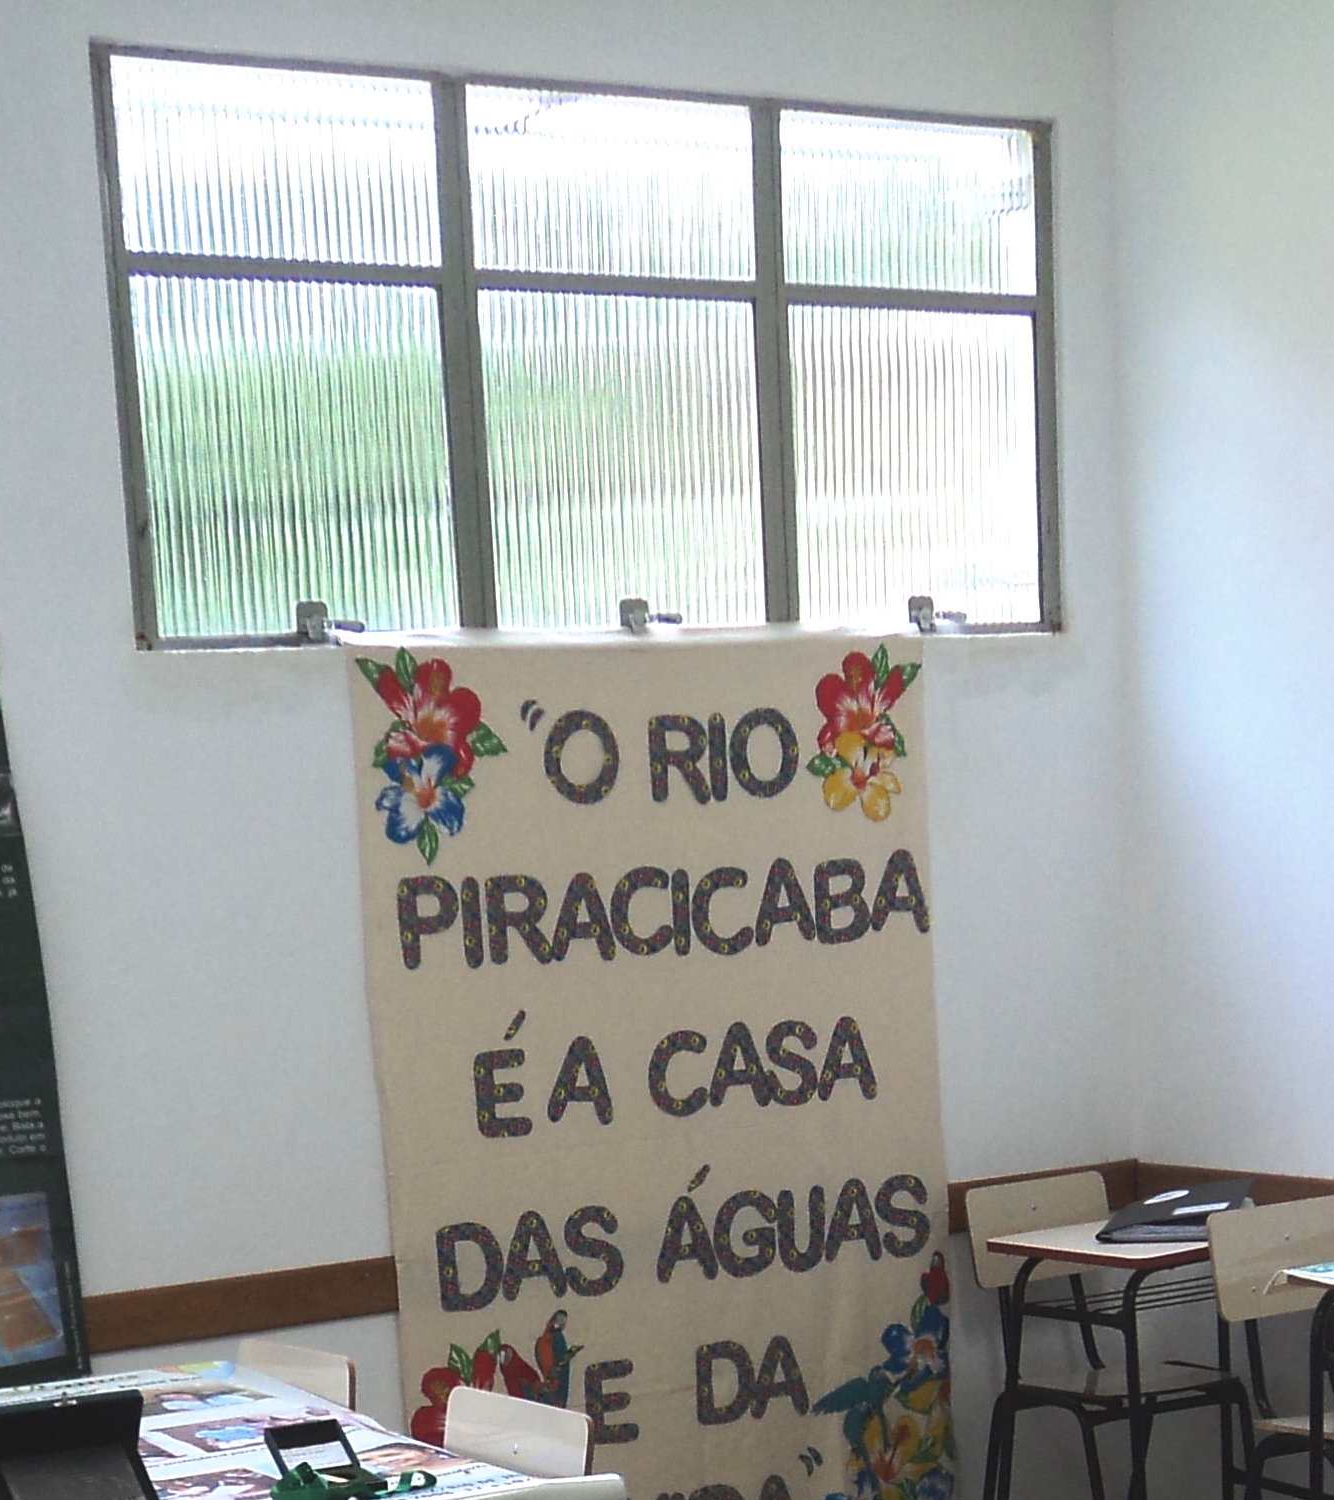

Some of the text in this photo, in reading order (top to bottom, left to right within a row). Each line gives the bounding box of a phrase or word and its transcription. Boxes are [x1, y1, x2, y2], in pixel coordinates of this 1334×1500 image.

[648, 707, 799, 805] RIO
[397, 848, 931, 969] PIRACICABA
[473, 1010, 877, 1138] É A CASA
[435, 1164, 931, 1312] DAS ÁGUAS
[585, 1335, 810, 1445] E DA
